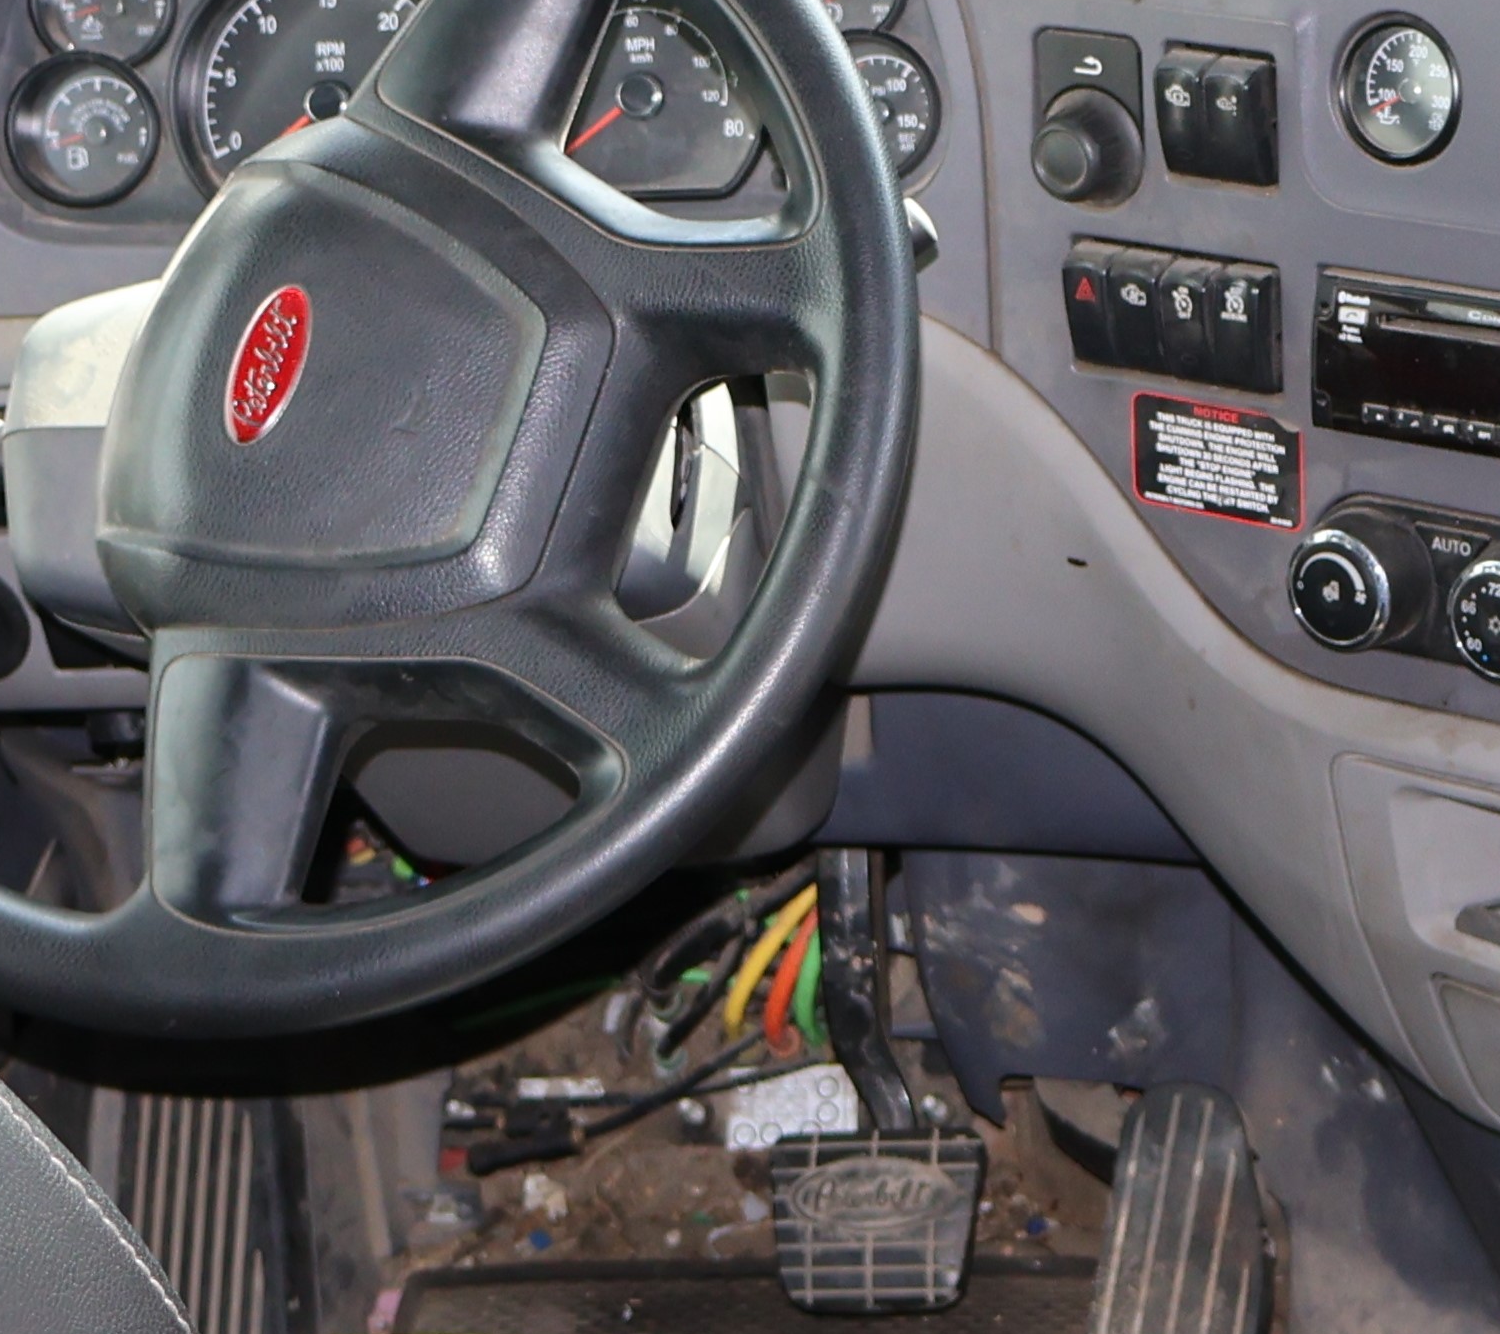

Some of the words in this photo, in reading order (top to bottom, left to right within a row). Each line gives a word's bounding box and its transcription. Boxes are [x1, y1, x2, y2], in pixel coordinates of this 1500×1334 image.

[257, 14, 278, 34] 10
[377, 11, 399, 31] 20
[315, 40, 346, 56] RPM
[625, 37, 655, 52] MPH
[1408, 45, 1428, 59] 200
[315, 57, 345, 72] x100
[1386, 58, 1404, 73] 150
[1429, 64, 1448, 79] 250
[224, 67, 237, 88] 5
[886, 77, 907, 92] 100
[702, 89, 720, 102] 120
[723, 118, 744, 137] 80
[897, 113, 918, 128] 150
[228, 130, 242, 150] 0
[233, 298, 298, 427] Peterbilt
[1193, 406, 1238, 423] NOTICE
[1431, 536, 1472, 557] AUTO
[1461, 600, 1476, 615] 66
[1466, 637, 1482, 652] 60
